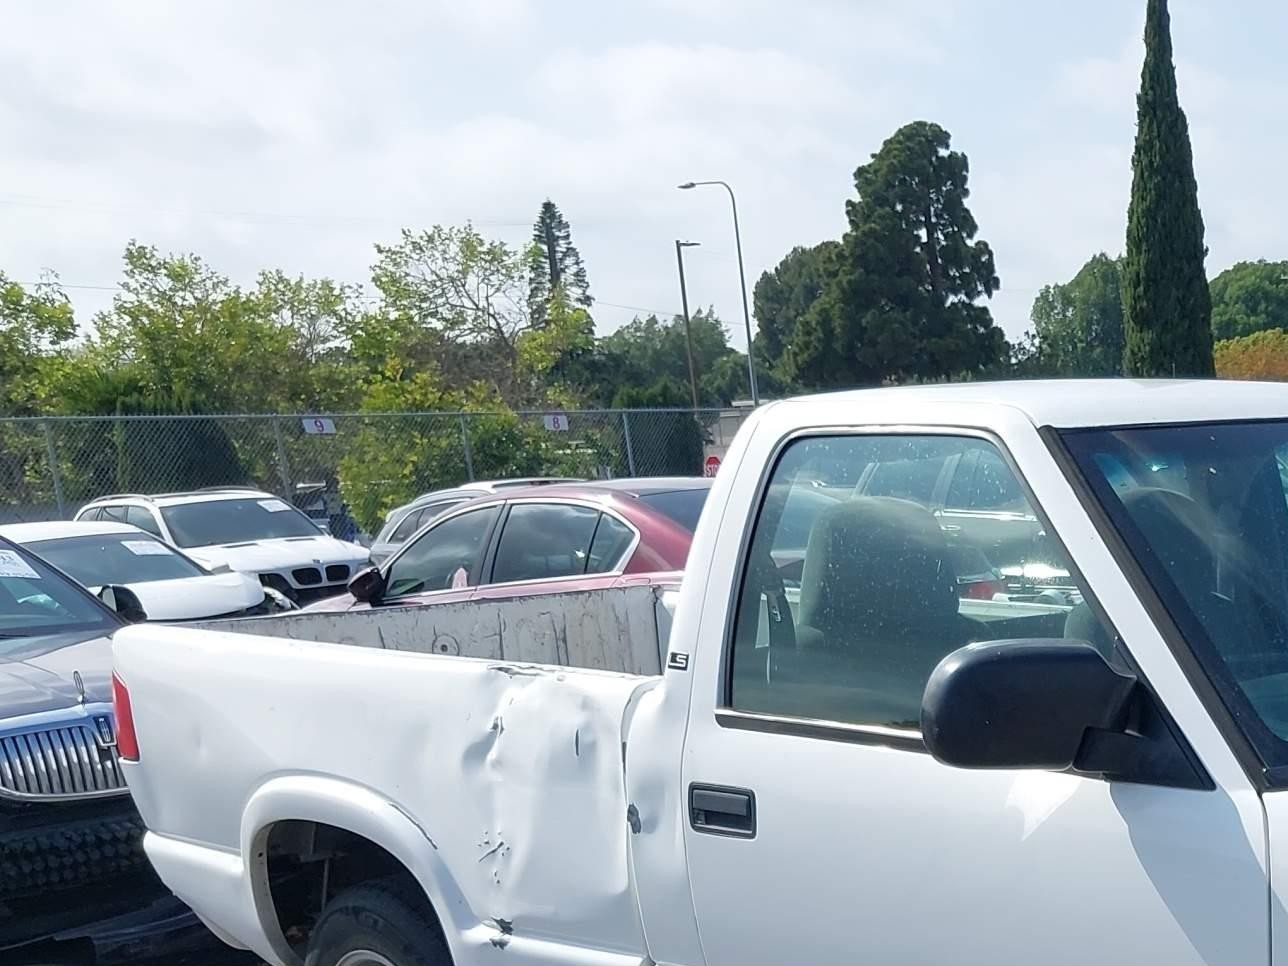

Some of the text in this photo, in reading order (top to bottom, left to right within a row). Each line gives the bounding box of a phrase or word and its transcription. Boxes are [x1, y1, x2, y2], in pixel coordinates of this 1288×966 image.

[314, 419, 325, 432] 9
[552, 416, 561, 430] 8
[705, 463, 720, 478] STO
[669, 654, 688, 668] LS
